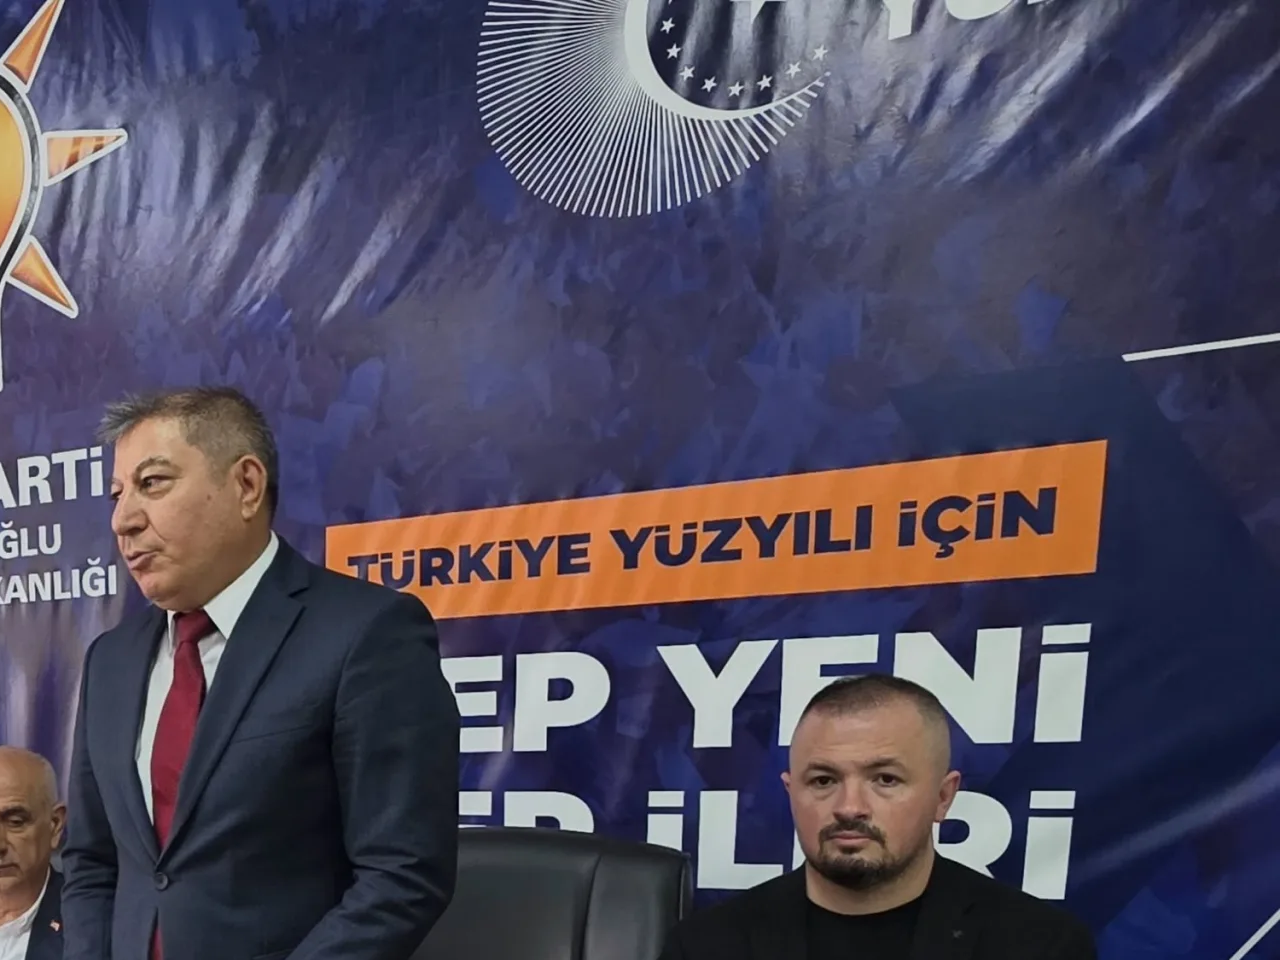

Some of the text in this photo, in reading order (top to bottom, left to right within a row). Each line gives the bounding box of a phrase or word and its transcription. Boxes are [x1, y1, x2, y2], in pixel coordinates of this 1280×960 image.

[347, 486, 1058, 591] TÜRKİYE YÜZYILI İÇİN
[440, 651, 612, 753] EP
